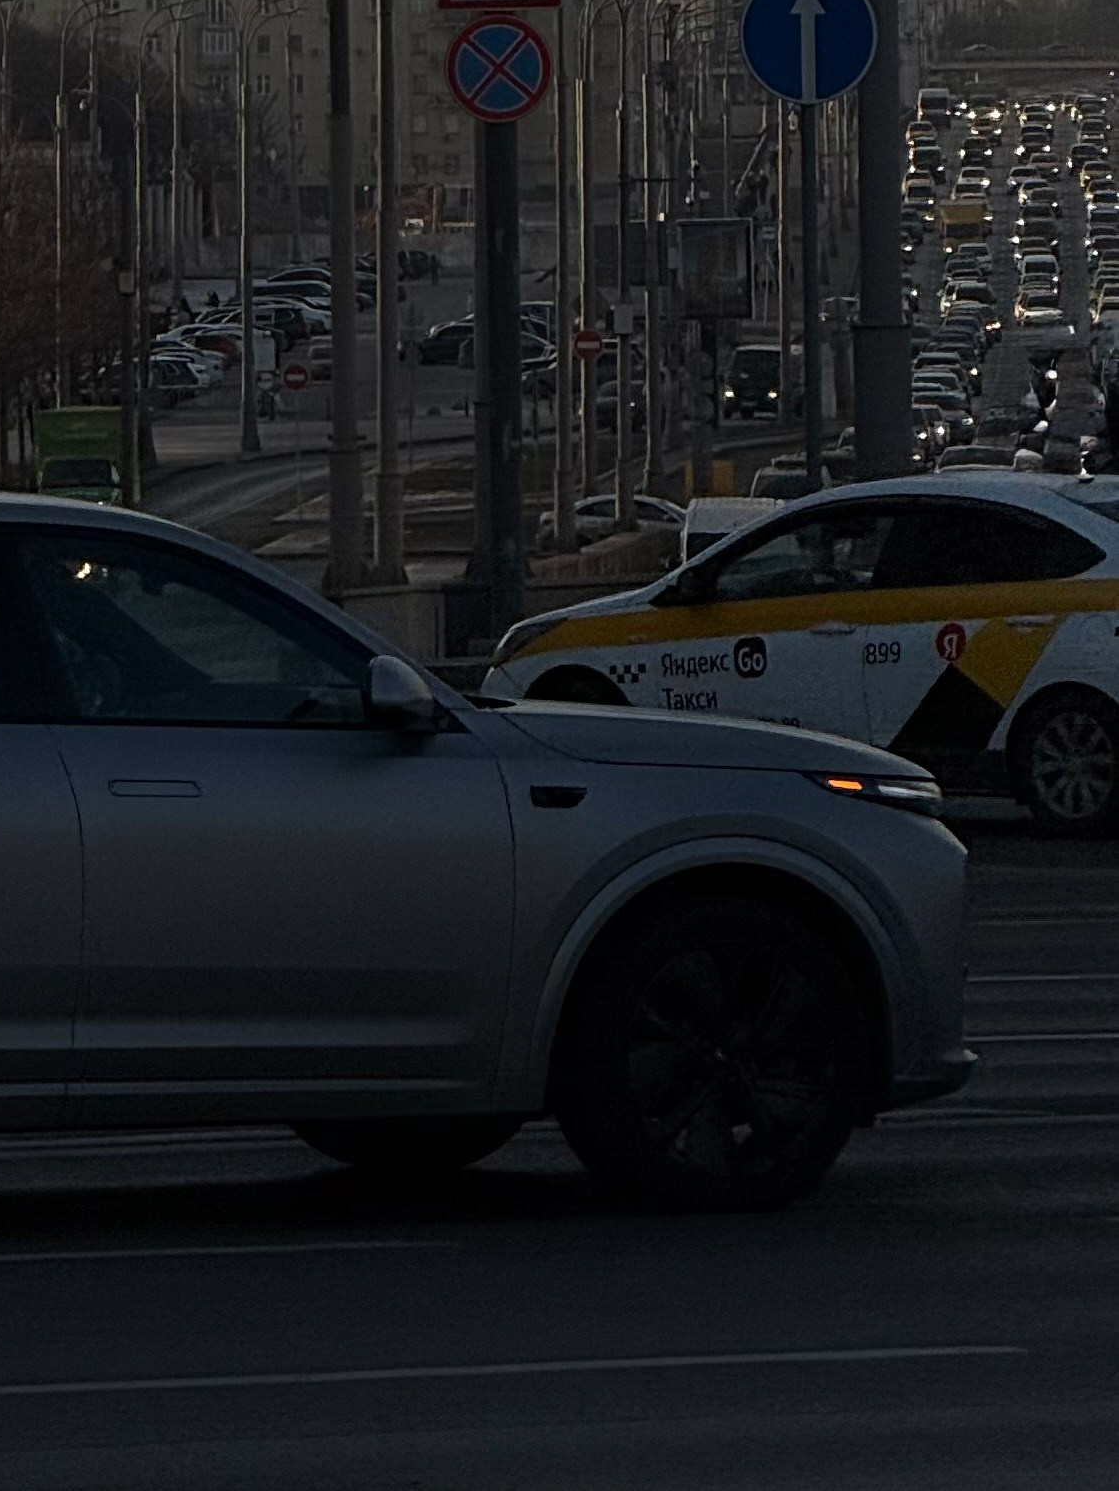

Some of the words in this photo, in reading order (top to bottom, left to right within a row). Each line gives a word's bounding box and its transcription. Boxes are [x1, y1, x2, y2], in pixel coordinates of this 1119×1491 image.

[661, 653, 731, 678] Яндекс
[738, 647, 764, 672] Go
[866, 642, 900, 664] 899
[662, 687, 718, 710] Такси
